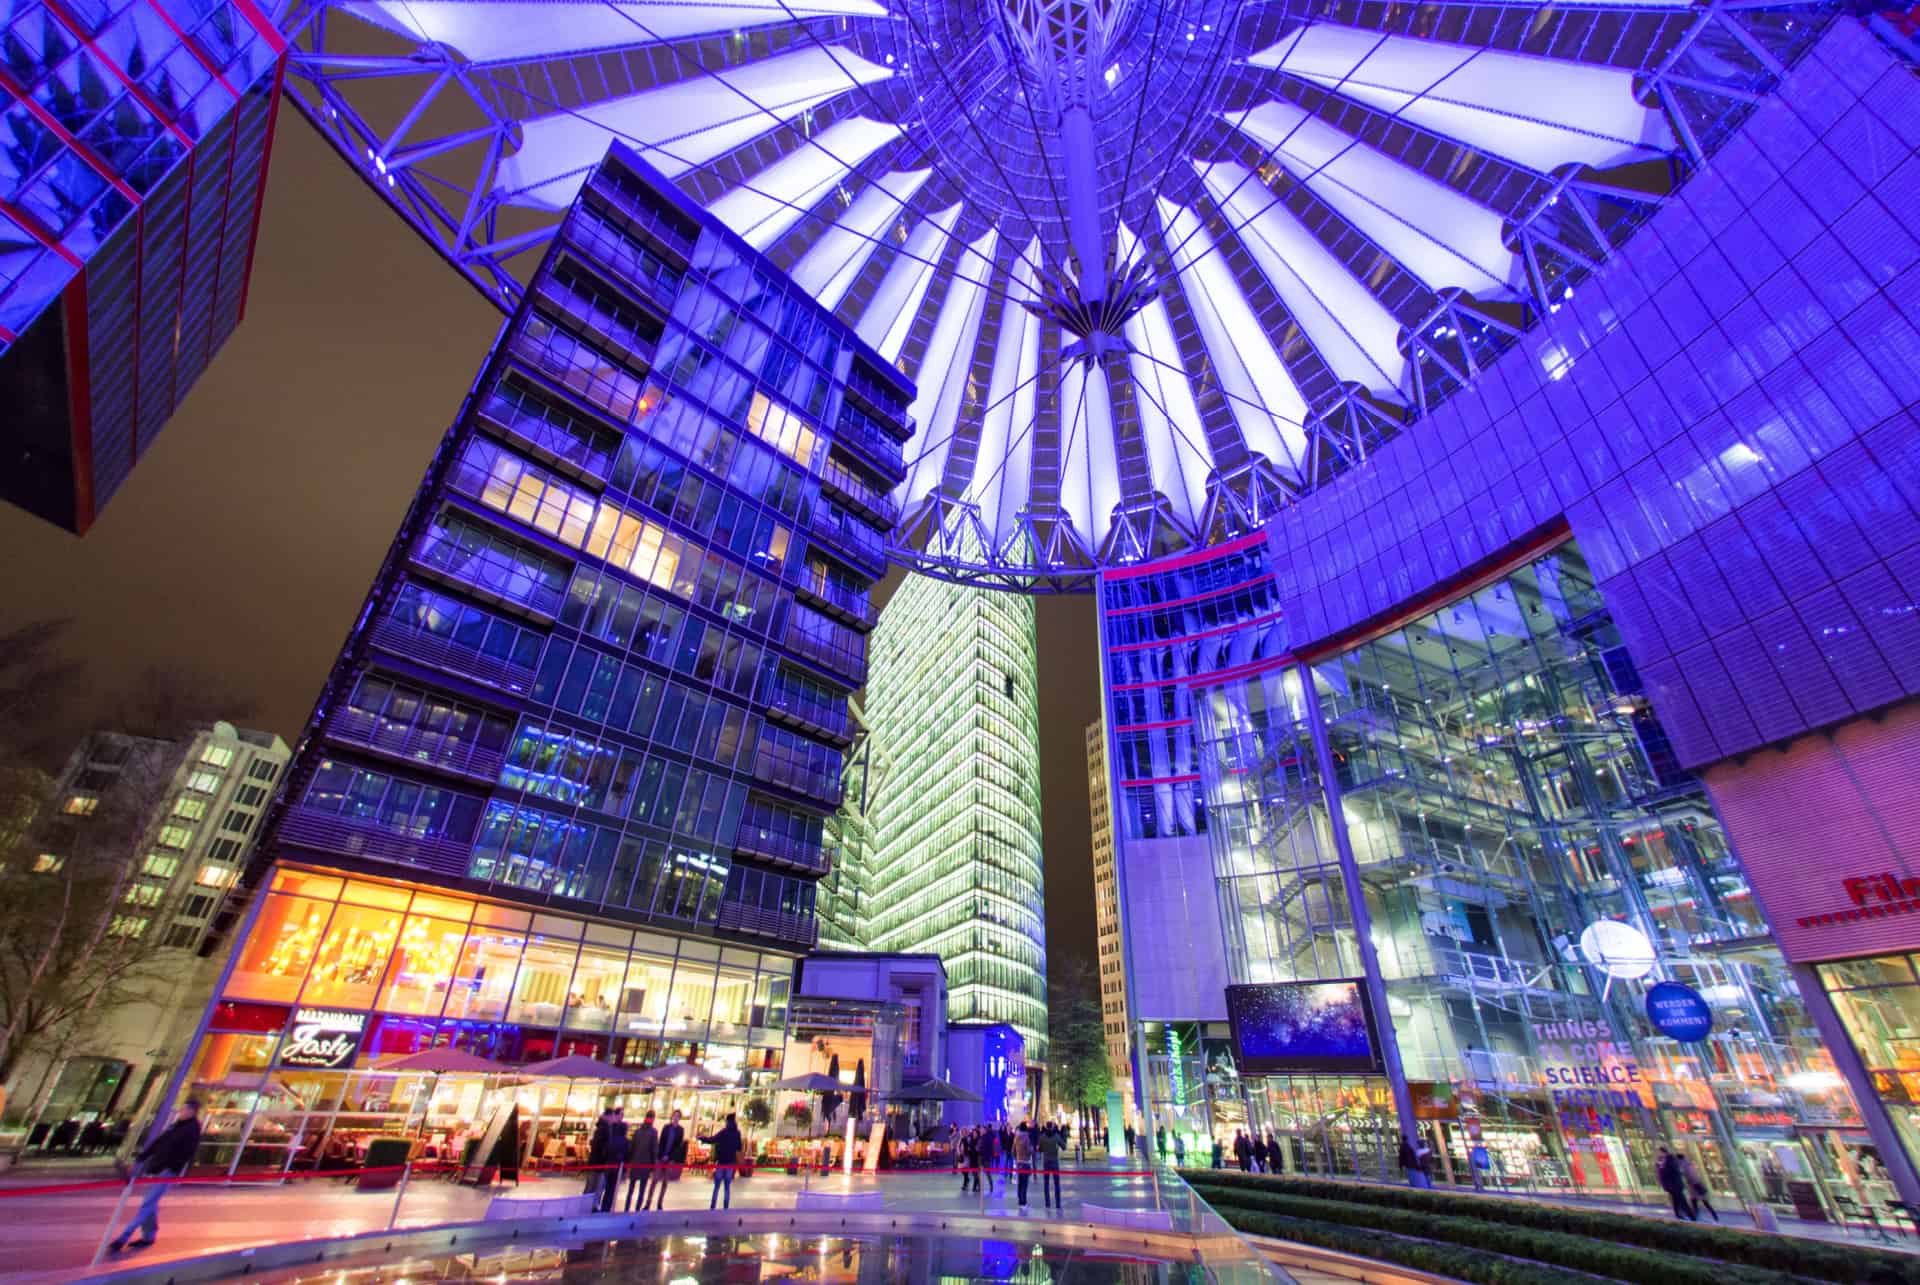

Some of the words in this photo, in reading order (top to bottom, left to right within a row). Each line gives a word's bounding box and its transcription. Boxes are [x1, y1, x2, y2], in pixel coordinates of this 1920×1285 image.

[296, 1008, 365, 1024] RESTAURANT
[1532, 1020, 1611, 1040] THINGS
[281, 1024, 356, 1067] Josty
[1570, 1040, 1635, 1060] COME
[1545, 1064, 1641, 1084] SCIENCE
[1552, 1088, 1643, 1107] FICTION
[1559, 1110, 1616, 1133] FILM
